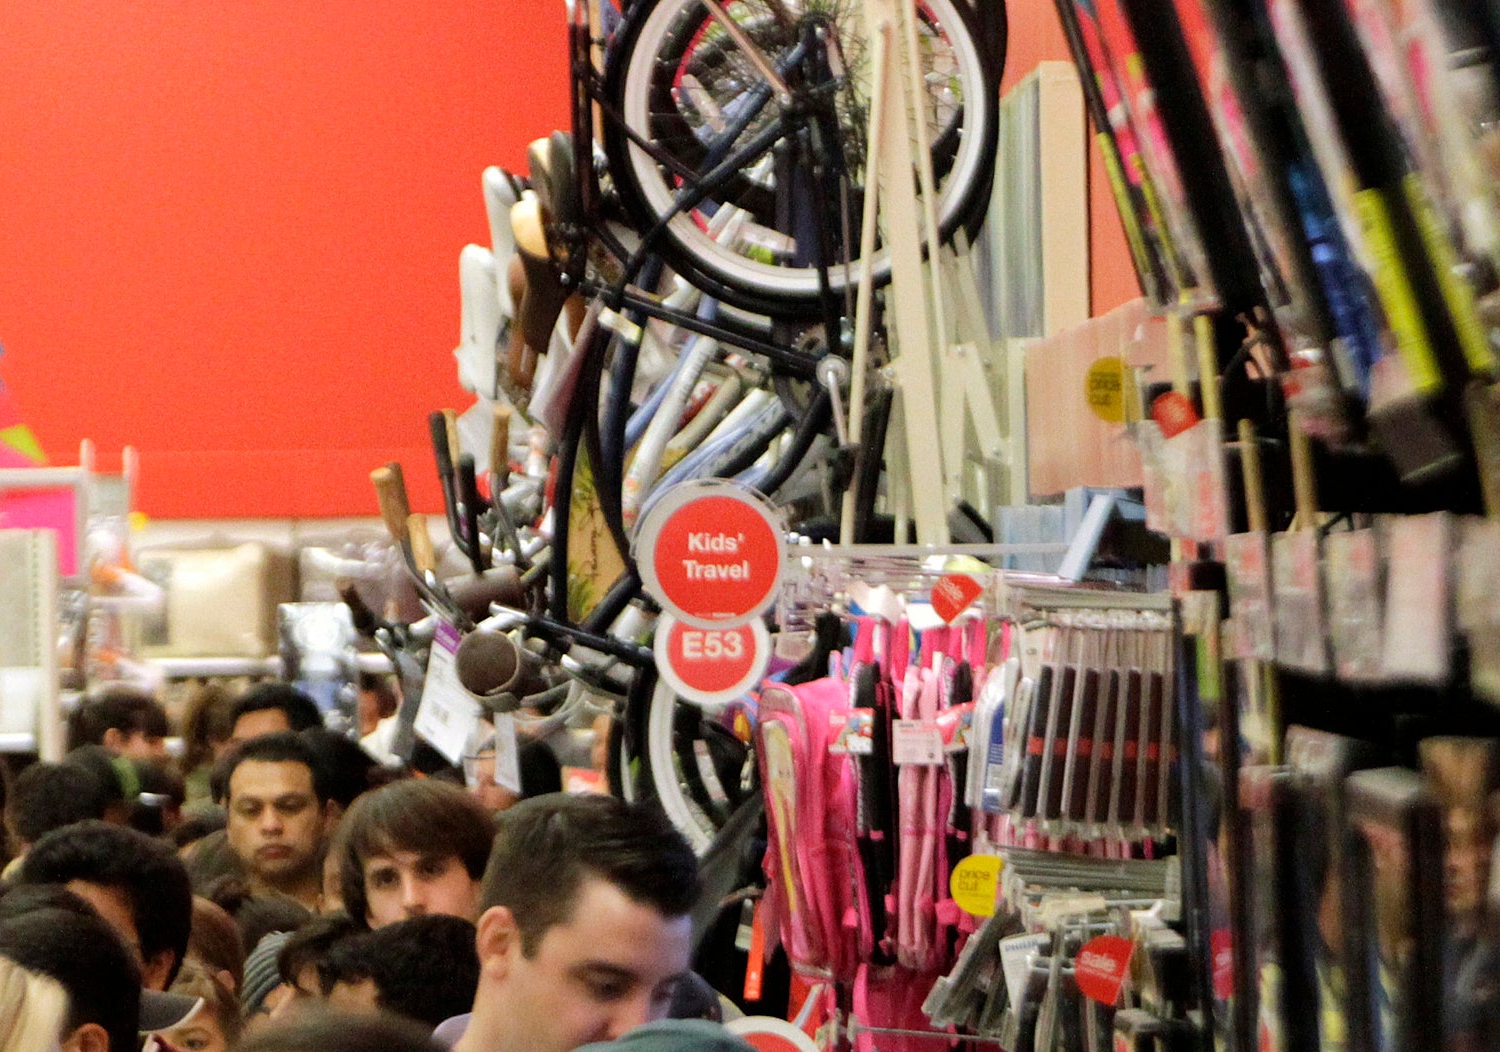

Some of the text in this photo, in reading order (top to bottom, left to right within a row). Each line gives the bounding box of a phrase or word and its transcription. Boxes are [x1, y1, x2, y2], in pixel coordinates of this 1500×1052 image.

[687, 532, 746, 553] Kids'
[682, 559, 750, 581] Travel
[681, 630, 744, 660] E53
